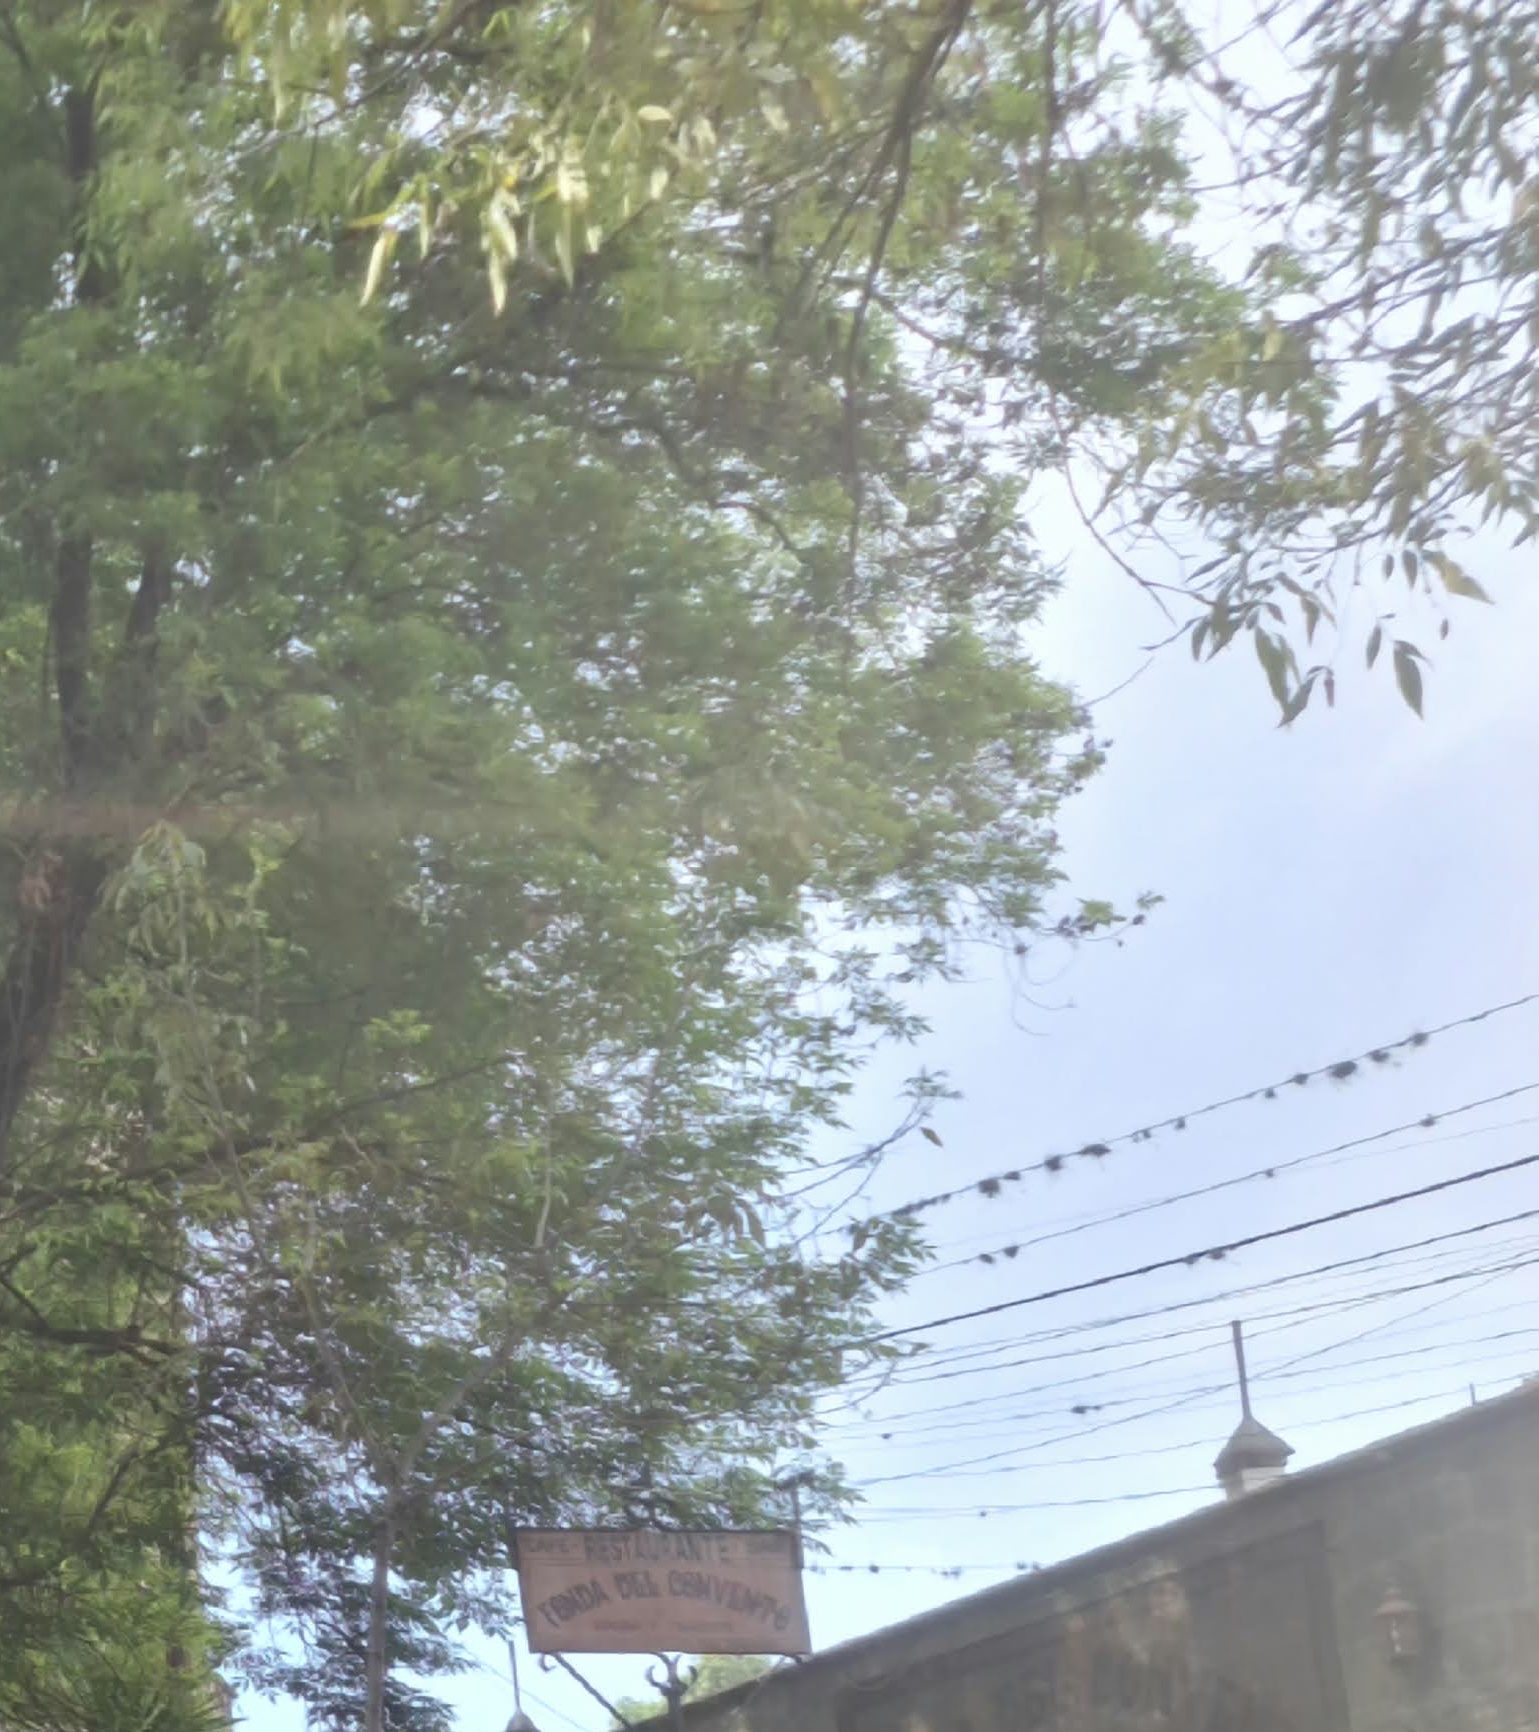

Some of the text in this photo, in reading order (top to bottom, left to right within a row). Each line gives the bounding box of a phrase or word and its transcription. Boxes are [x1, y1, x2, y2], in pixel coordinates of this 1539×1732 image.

[584, 1534, 730, 1562] RESTAURANTE
[615, 1571, 660, 1600] DEL
[668, 1570, 791, 1631] CONVENTO
